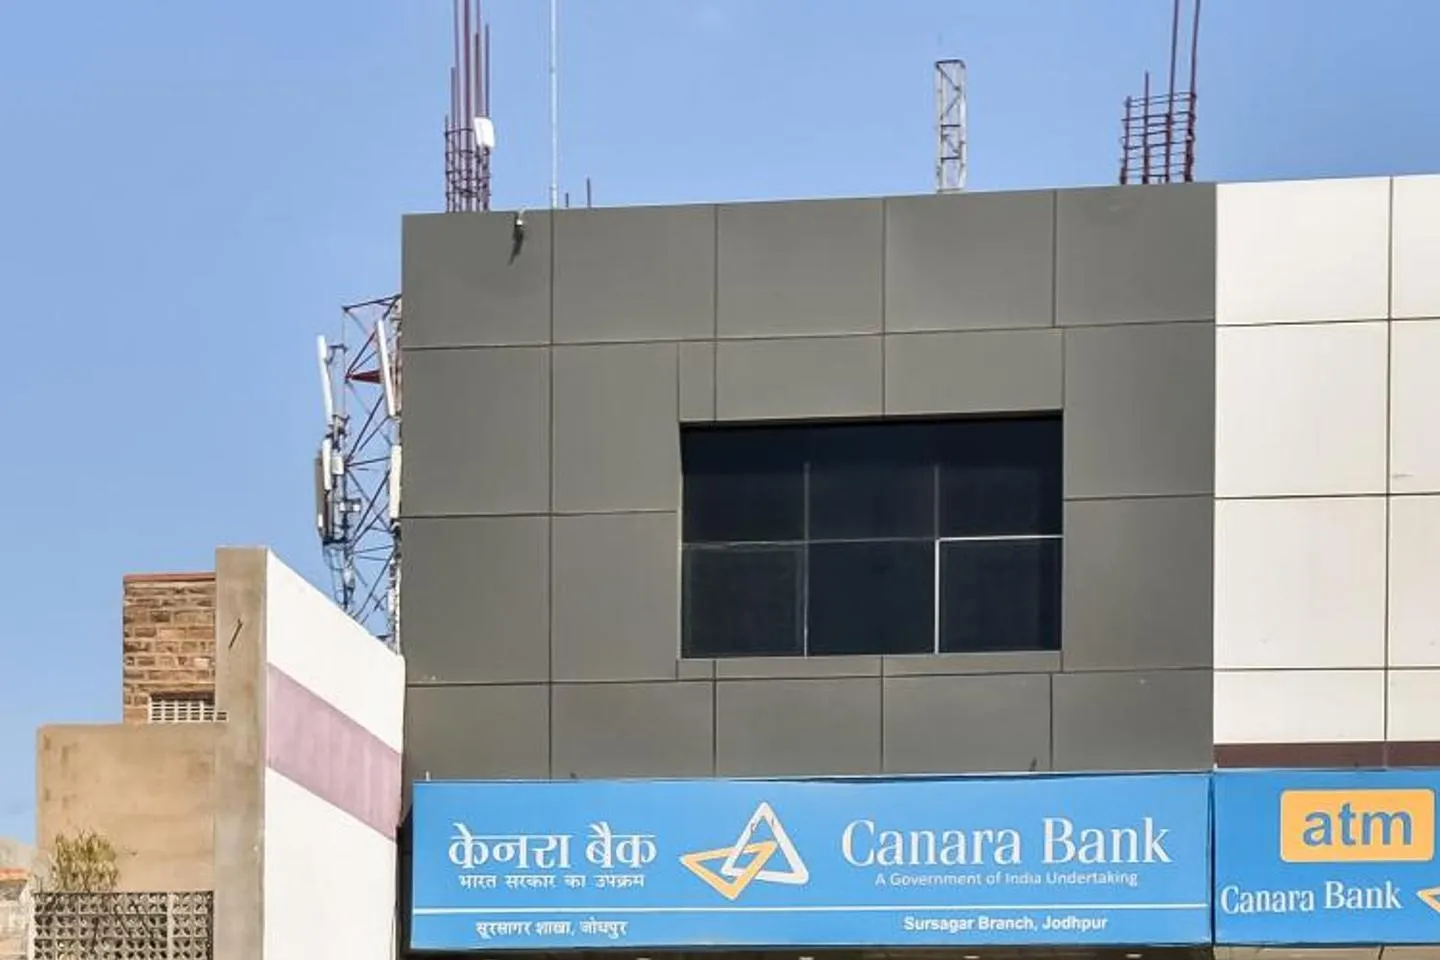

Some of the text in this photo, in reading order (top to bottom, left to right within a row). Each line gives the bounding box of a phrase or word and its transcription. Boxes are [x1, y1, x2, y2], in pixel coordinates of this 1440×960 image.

[1302, 801, 1414, 847] atm
[448, 821, 573, 869] केनरा
[841, 816, 1173, 867] Canara Bank
[458, 874, 645, 889] भारत सरकार का उपक्रम
[875, 871, 1138, 888] A Government of India Undertaking
[1220, 879, 1404, 914] Canara Bank
[475, 920, 531, 940] सूरसागर
[580, 917, 629, 940] जोधपुर
[903, 914, 1108, 933] Sursagar Branch, Jodhpur
